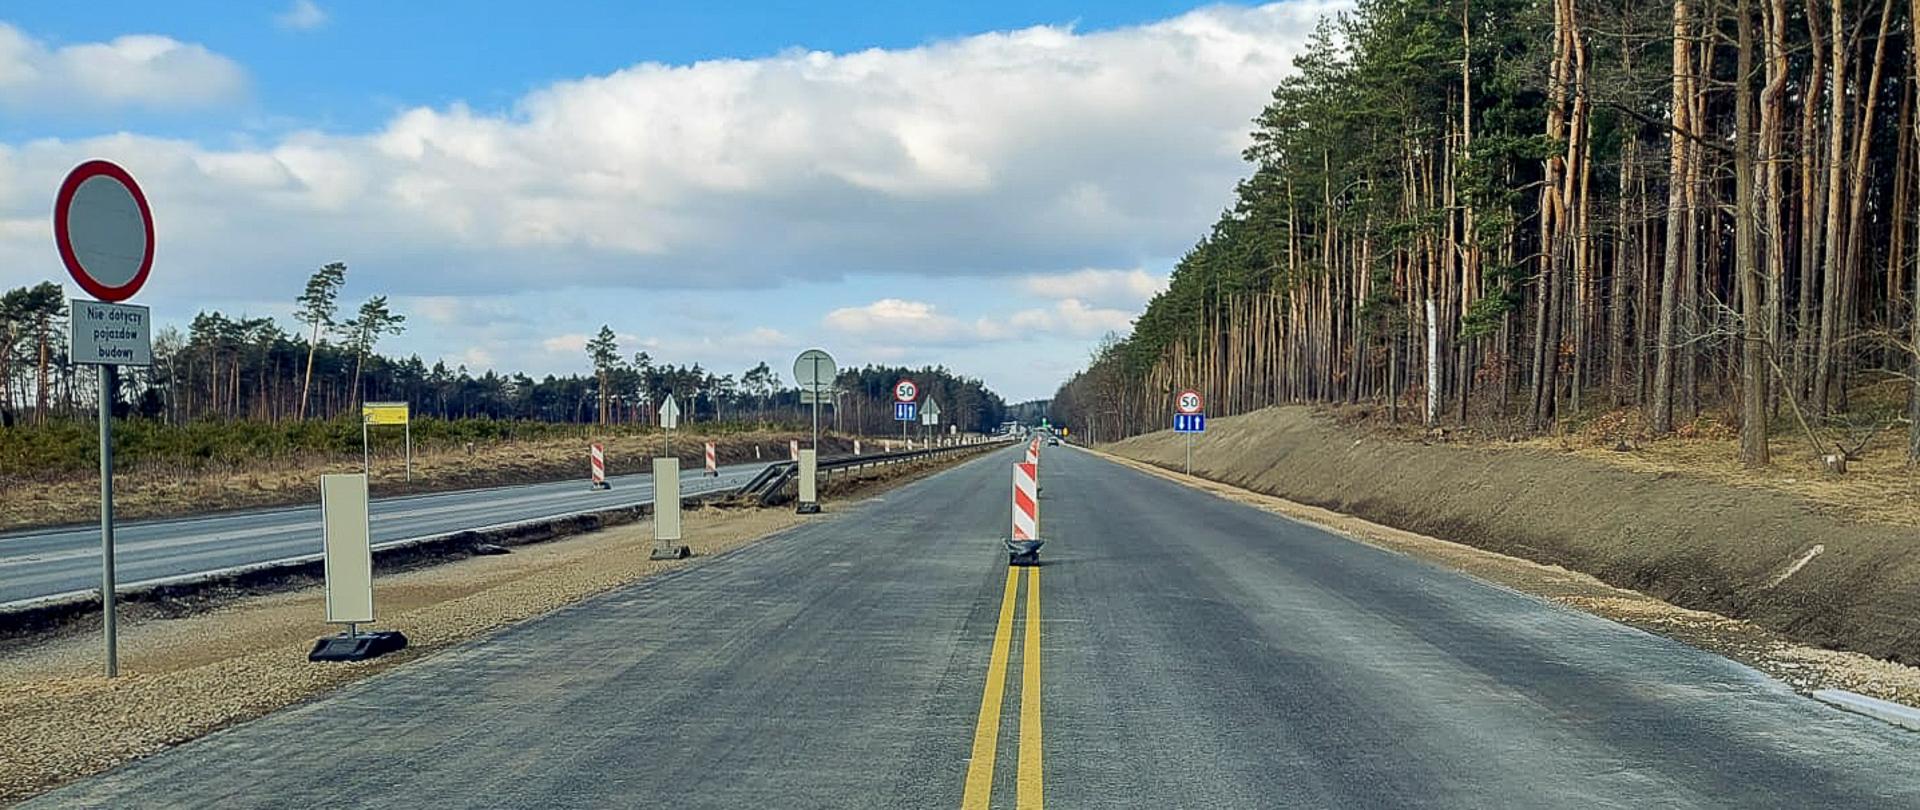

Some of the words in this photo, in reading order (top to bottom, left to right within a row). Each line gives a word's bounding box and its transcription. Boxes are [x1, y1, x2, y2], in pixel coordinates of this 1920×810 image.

[87, 306, 104, 320] Nie
[108, 308, 141, 325] dotyczy
[94, 327, 137, 341] pojazdów
[98, 345, 133, 361] budowy
[899, 385, 914, 397] 50
[1182, 396, 1198, 408] 50
